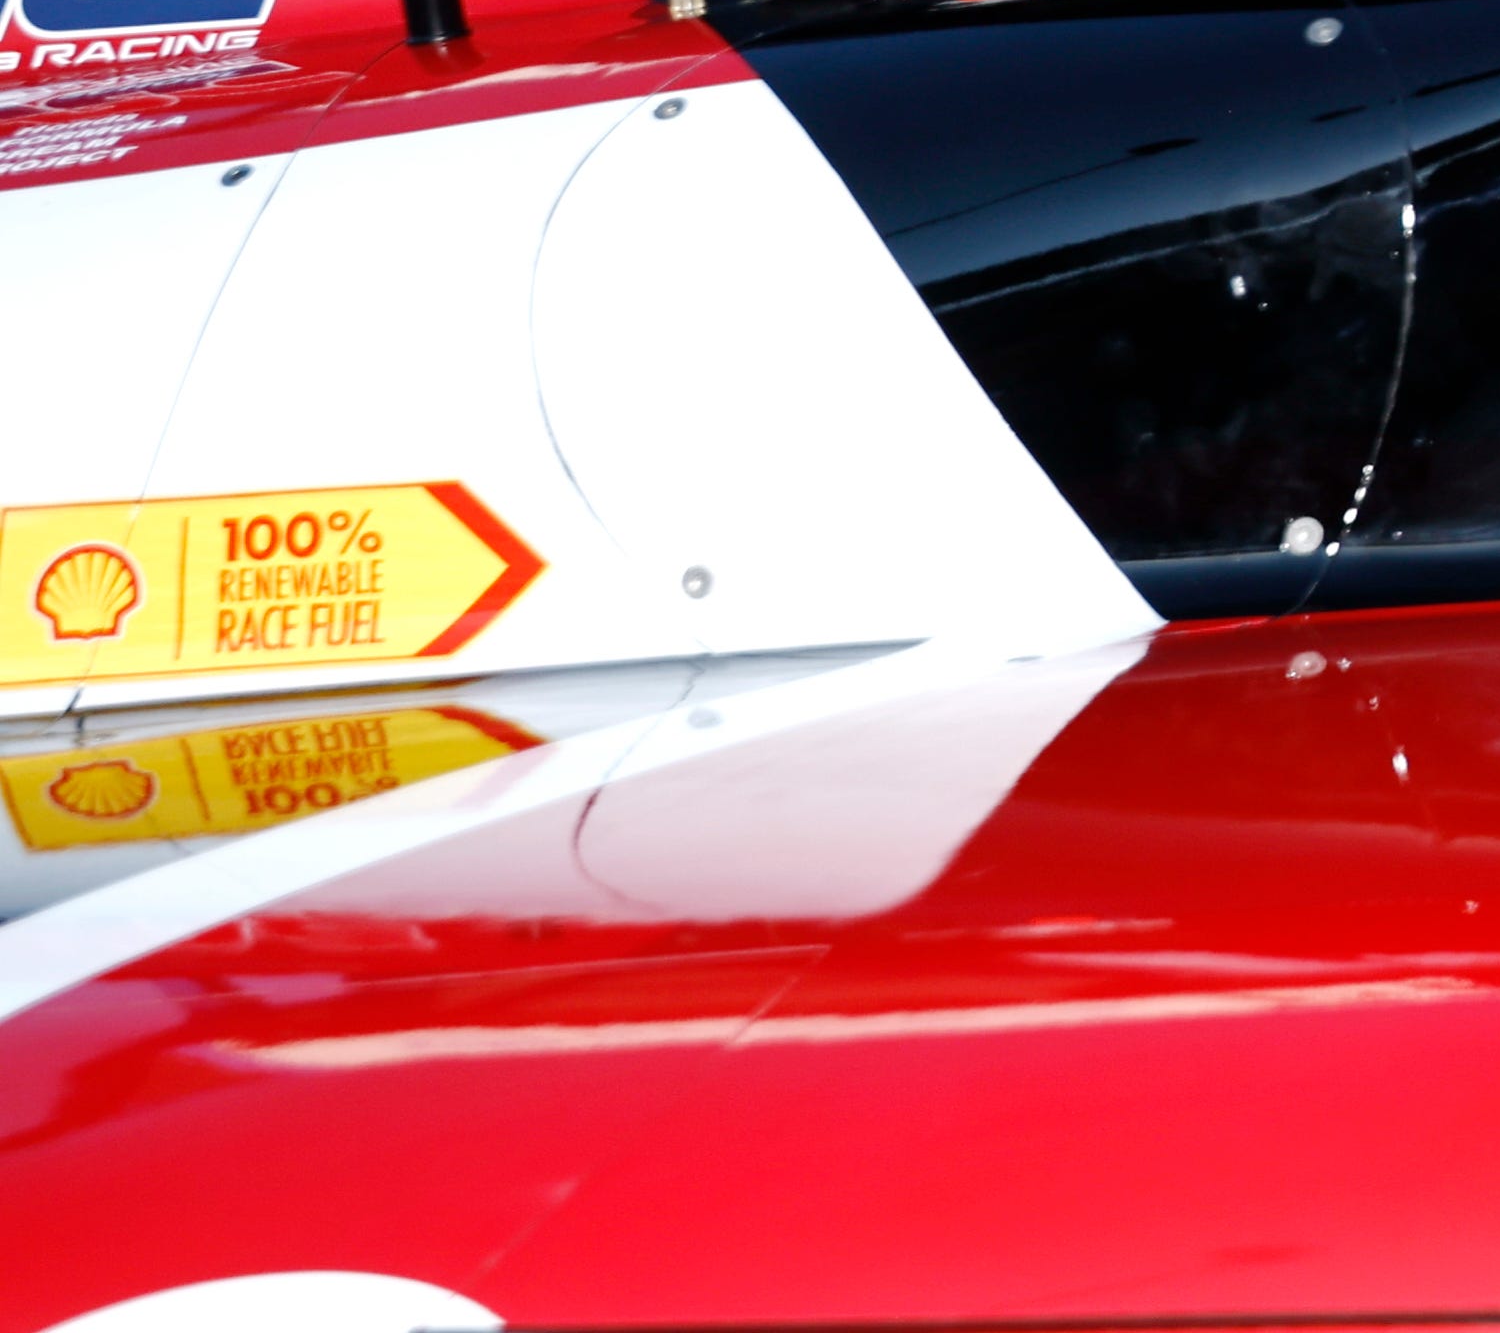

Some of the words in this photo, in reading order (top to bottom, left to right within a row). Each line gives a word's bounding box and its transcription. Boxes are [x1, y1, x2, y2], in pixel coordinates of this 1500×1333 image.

[30, 30, 262, 69] RACING
[0, 145, 140, 176] OJECT
[221, 509, 384, 563] 100%
[218, 559, 385, 603] RENEWABLE
[215, 604, 300, 653] RACE
[308, 599, 387, 648] FUEL
